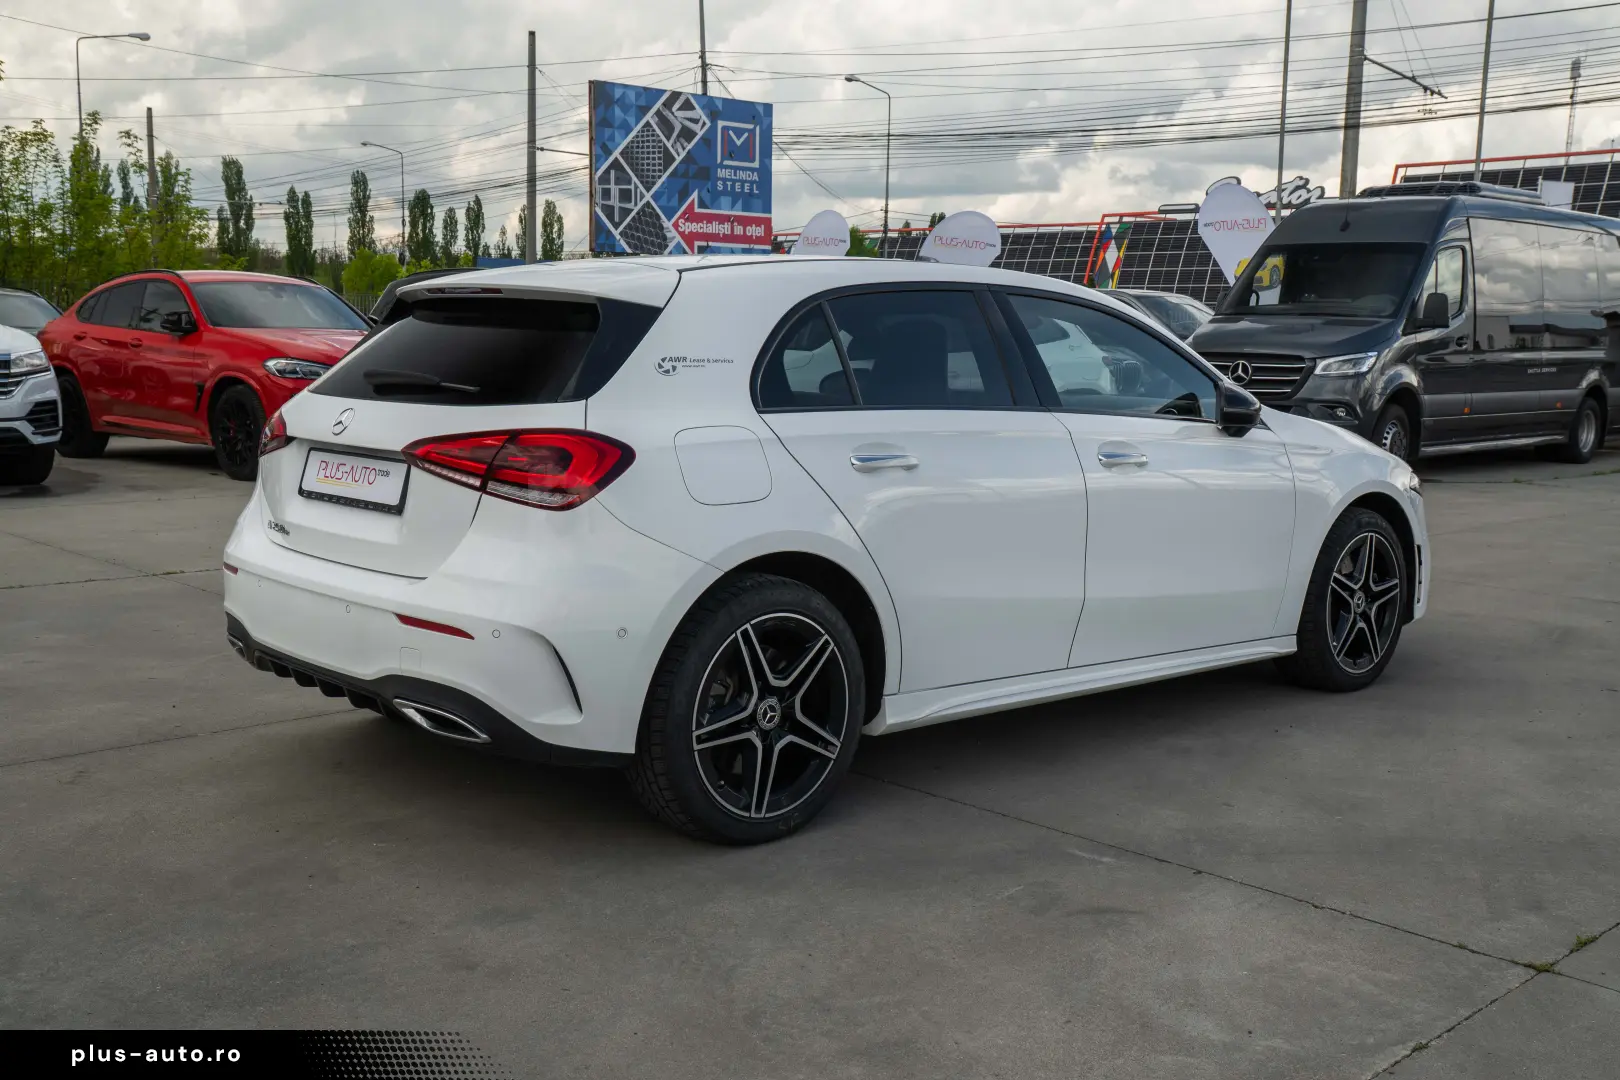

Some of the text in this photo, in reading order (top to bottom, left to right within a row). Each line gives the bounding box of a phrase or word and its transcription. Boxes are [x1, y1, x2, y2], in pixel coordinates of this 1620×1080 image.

[717, 168, 760, 182] MELINDA
[716, 180, 760, 194] STEEL
[677, 218, 765, 240] Specialiști în oțel
[803, 236, 839, 248] PLUS-AUTO
[933, 235, 986, 250] PLUS-AUTO
[316, 460, 391, 486] PLUS-AUTO trade
